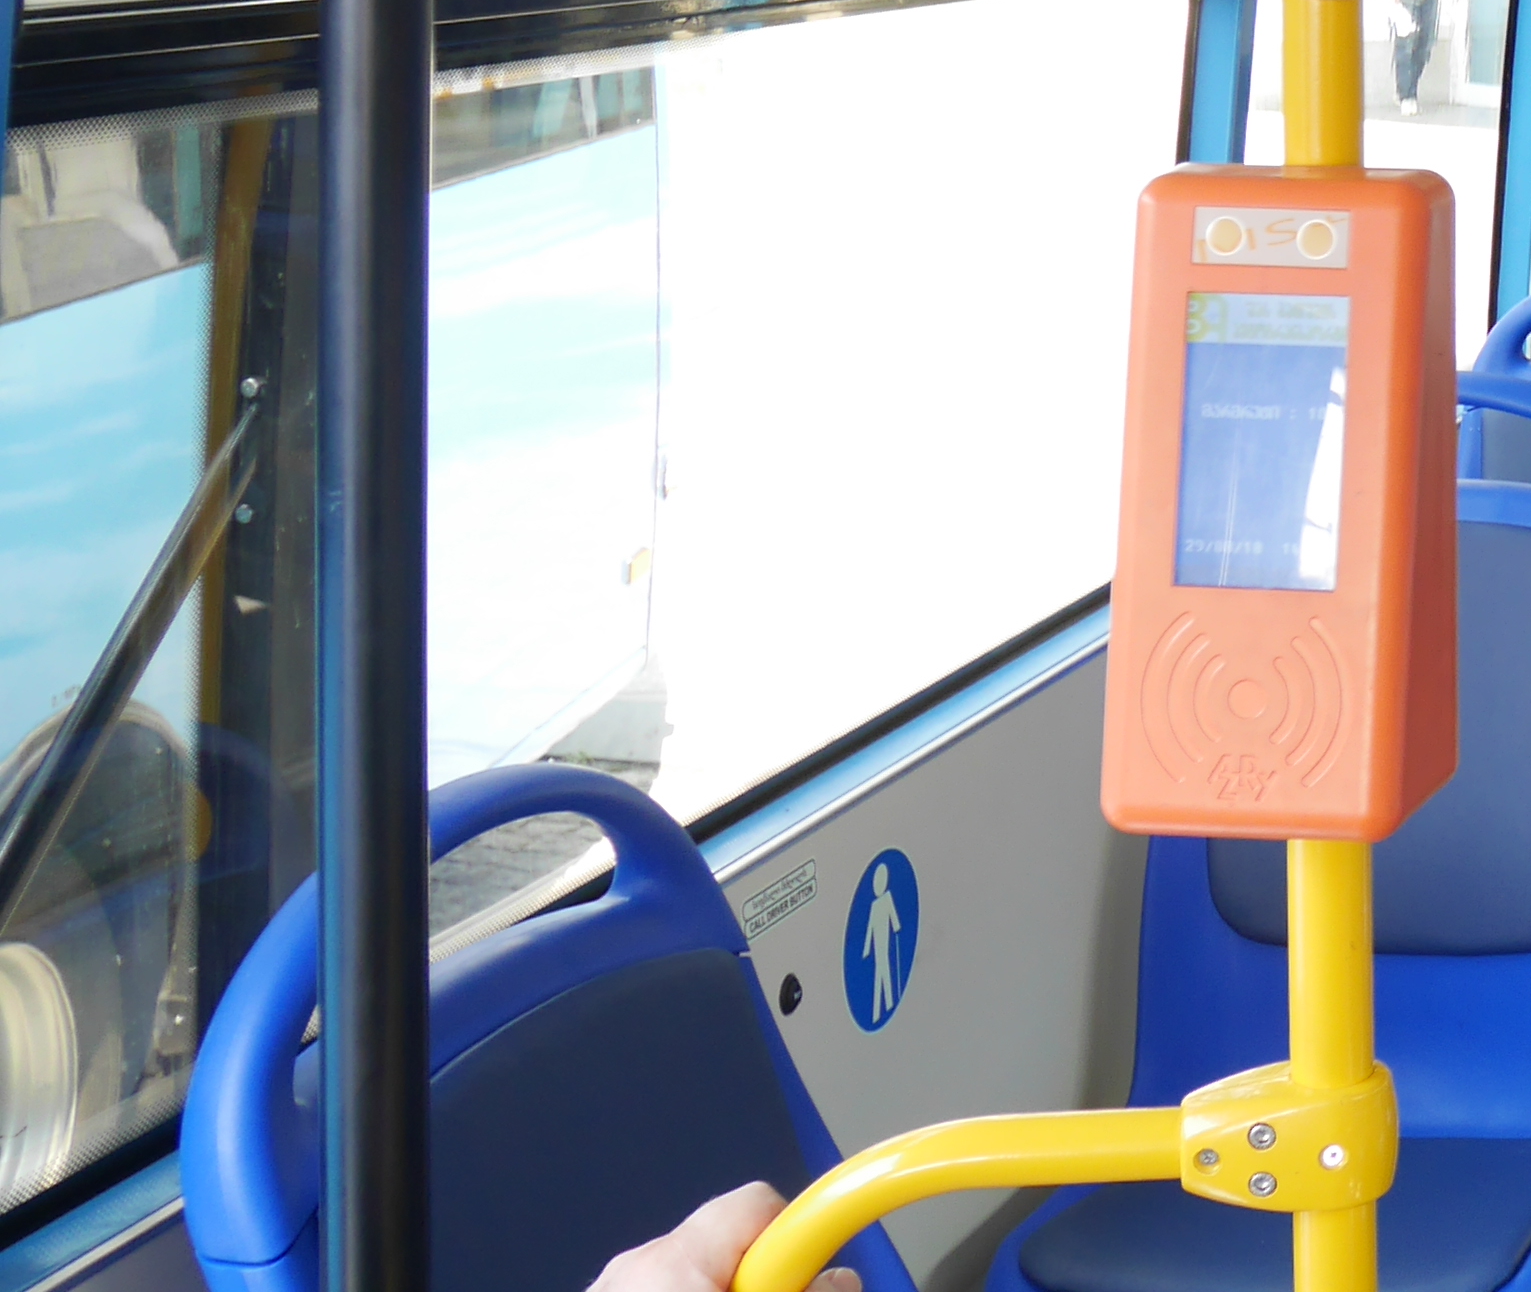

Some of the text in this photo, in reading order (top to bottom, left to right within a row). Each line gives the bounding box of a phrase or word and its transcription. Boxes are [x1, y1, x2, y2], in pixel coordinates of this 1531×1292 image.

[749, 916, 766, 933] CALL
[766, 899, 788, 921] DRIVER
[789, 883, 814, 907] BUTTON
